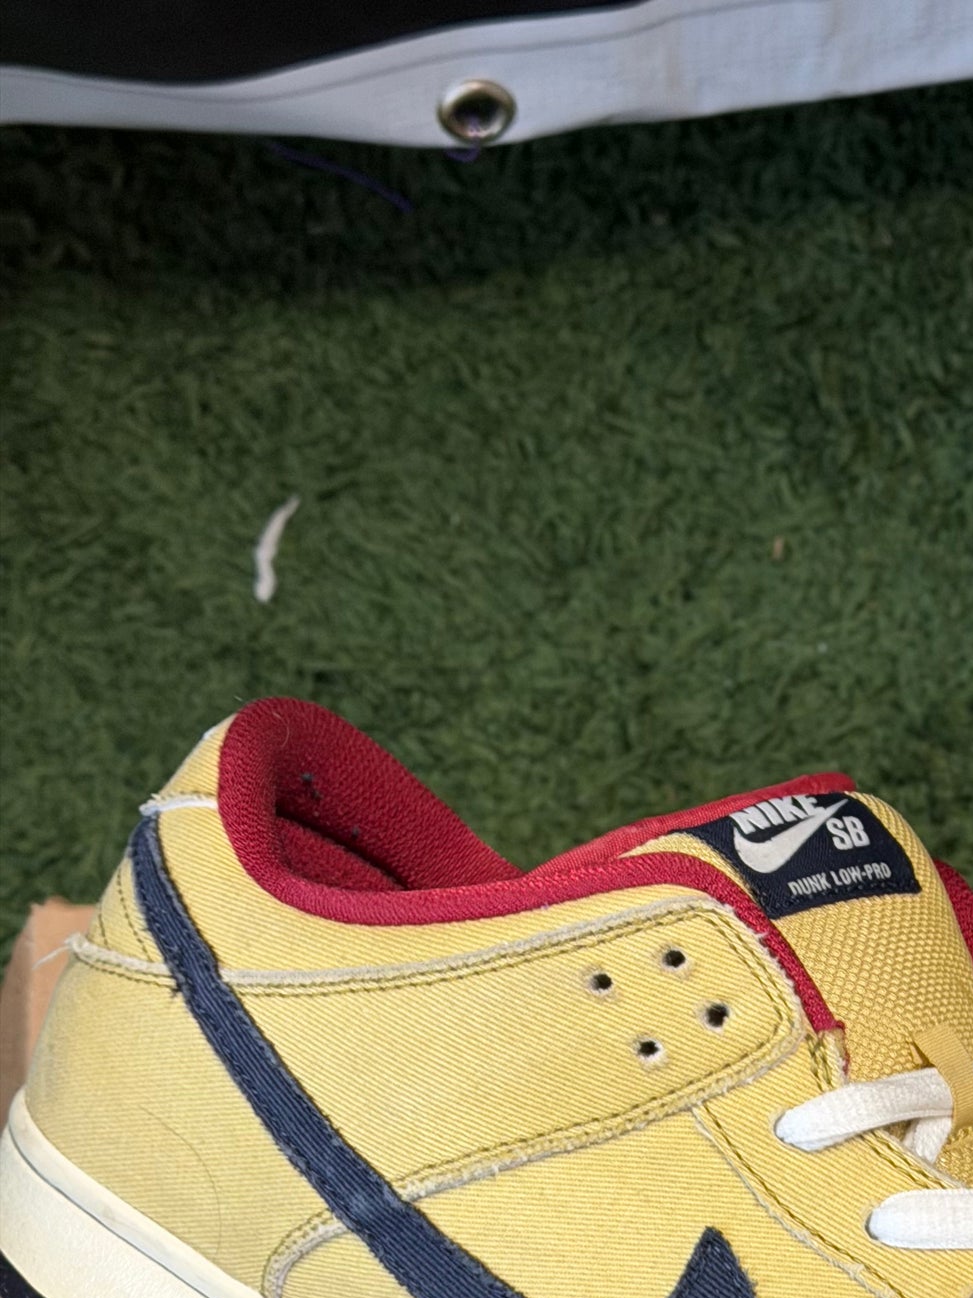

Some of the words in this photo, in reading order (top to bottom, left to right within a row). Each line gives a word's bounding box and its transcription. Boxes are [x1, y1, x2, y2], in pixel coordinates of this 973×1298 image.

[729, 795, 825, 835] NIKE
[826, 816, 870, 850] SB
[787, 872, 831, 896] DUNK
[830, 862, 892, 886] LOW-PRO
